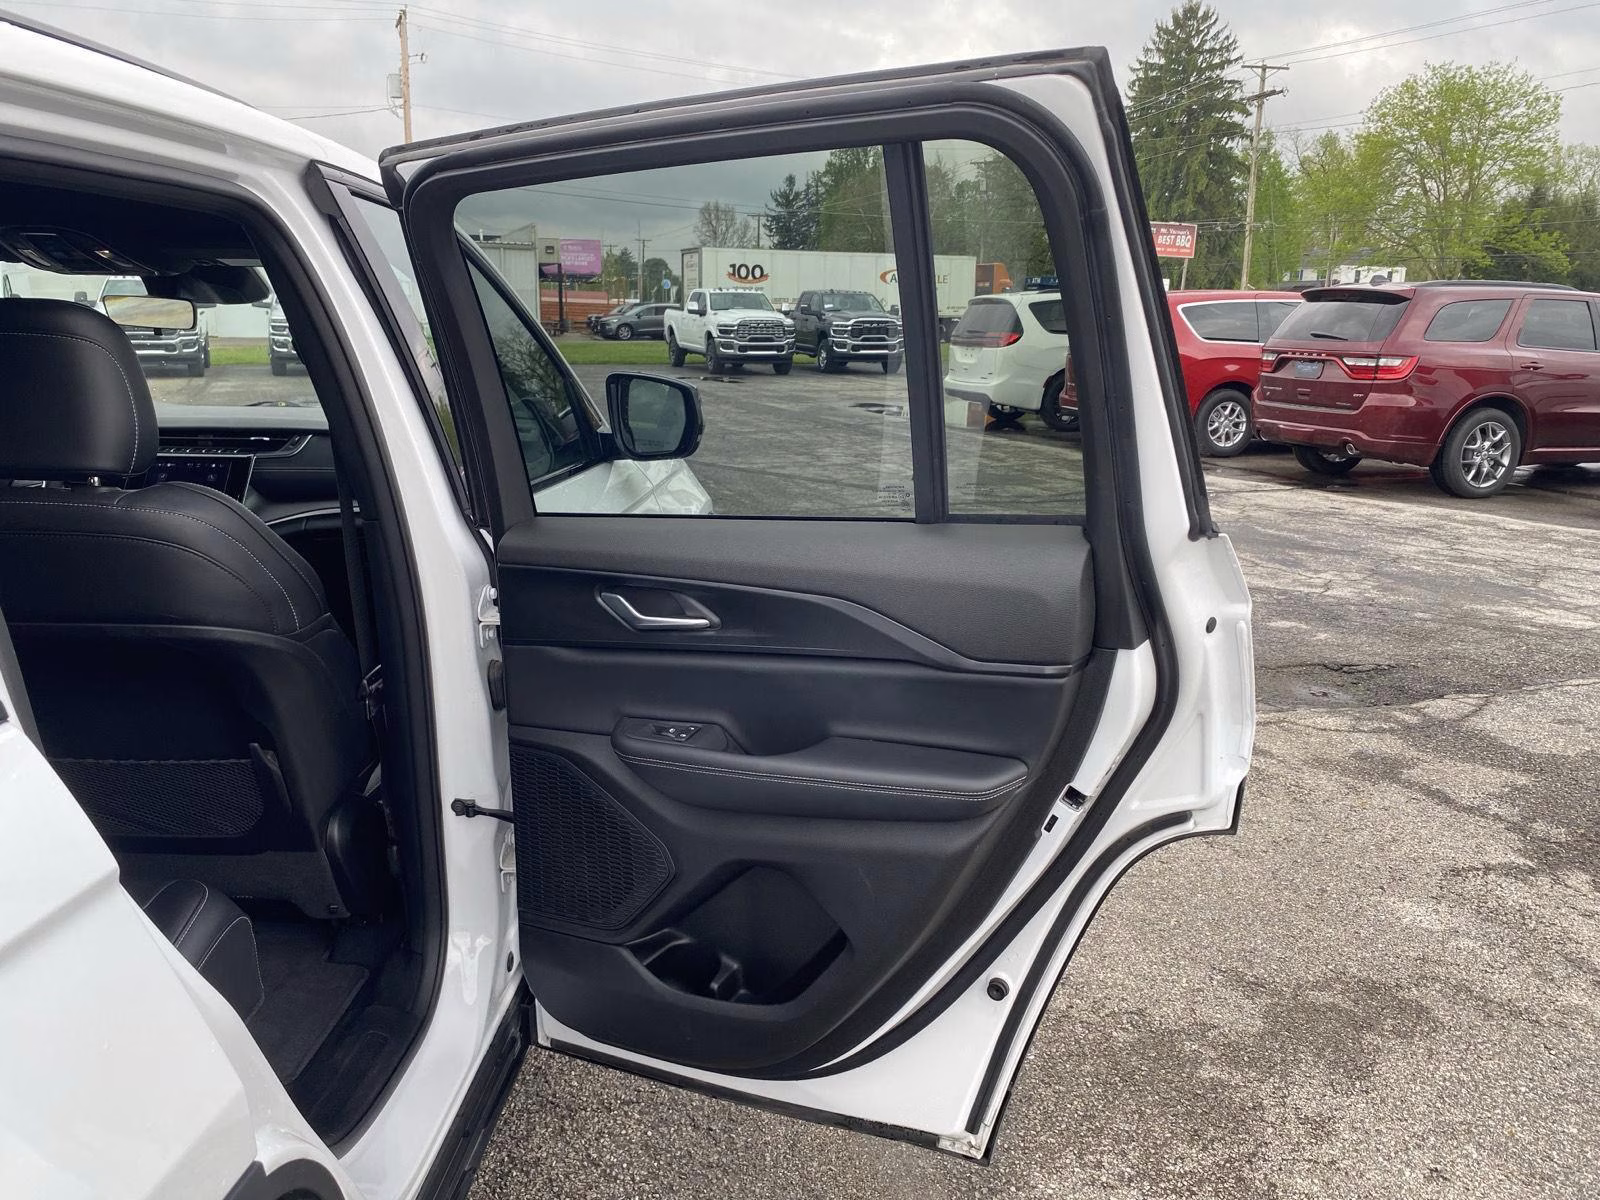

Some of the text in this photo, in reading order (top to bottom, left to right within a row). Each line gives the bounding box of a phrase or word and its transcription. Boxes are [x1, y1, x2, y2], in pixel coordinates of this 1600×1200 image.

[1157, 235, 1192, 248] BEST BBQ
[729, 263, 764, 280] 100
[937, 275, 949, 284] LE
